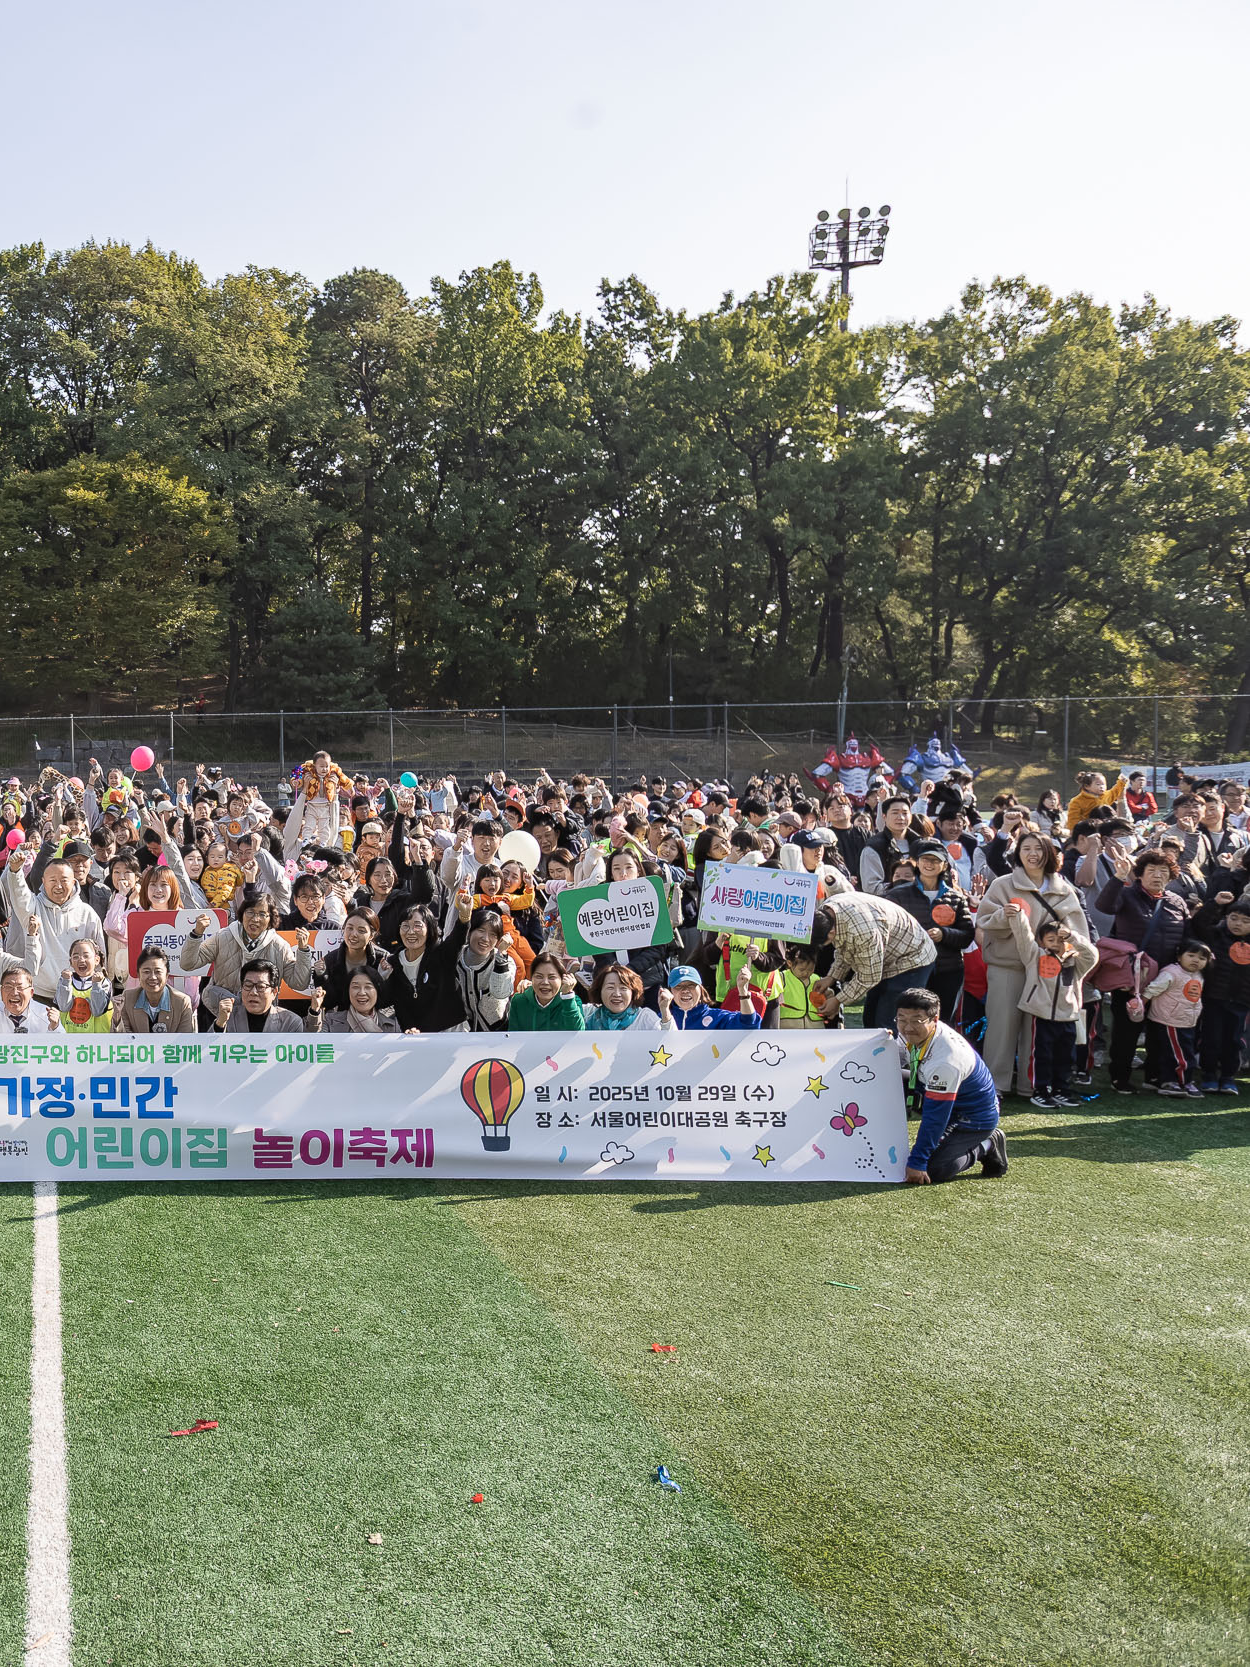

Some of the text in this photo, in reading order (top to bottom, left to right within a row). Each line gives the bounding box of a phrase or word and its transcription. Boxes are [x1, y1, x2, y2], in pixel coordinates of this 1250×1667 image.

[710, 885, 808, 917] 사랑어린이집
[578, 901, 655, 928] 예랑어린이집
[76, 1045, 155, 1065] 하나되어
[163, 1045, 202, 1064] 함께
[209, 1044, 268, 1064] 키우는
[275, 1044, 335, 1064] 아이들
[534, 1085, 775, 1103] 일 시: 2025년 10월 29일 (수)
[535, 1110, 788, 1129] 장 소: 서울어린이대공원 축구장
[47, 1127, 435, 1169] 어린이집 놀이축제
